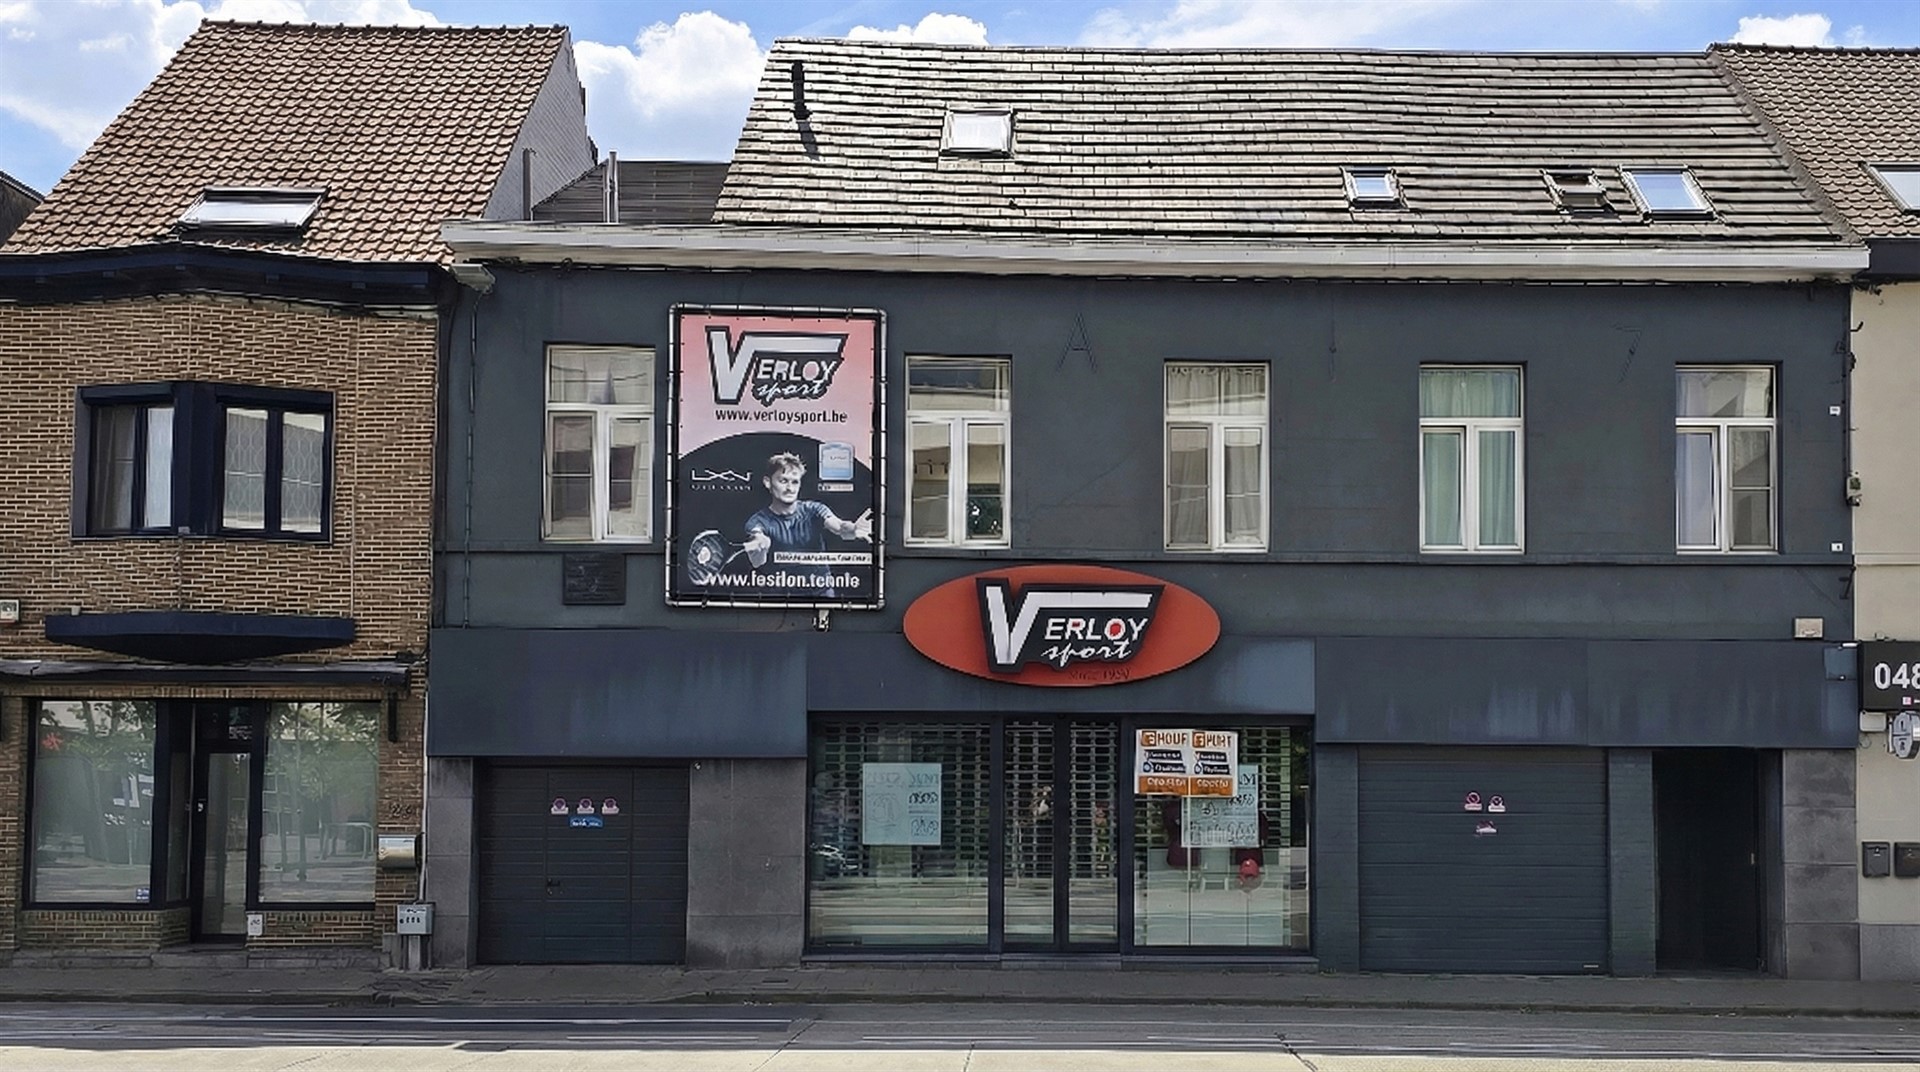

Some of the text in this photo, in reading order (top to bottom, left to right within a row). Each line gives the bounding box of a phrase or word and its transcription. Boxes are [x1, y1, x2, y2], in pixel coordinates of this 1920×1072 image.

[708, 329, 844, 401] VERLOY
[757, 379, 825, 402] sport
[985, 585, 1153, 664] VERLOY
[1040, 640, 1132, 667] sport
[1874, 662, 1920, 690] 048
